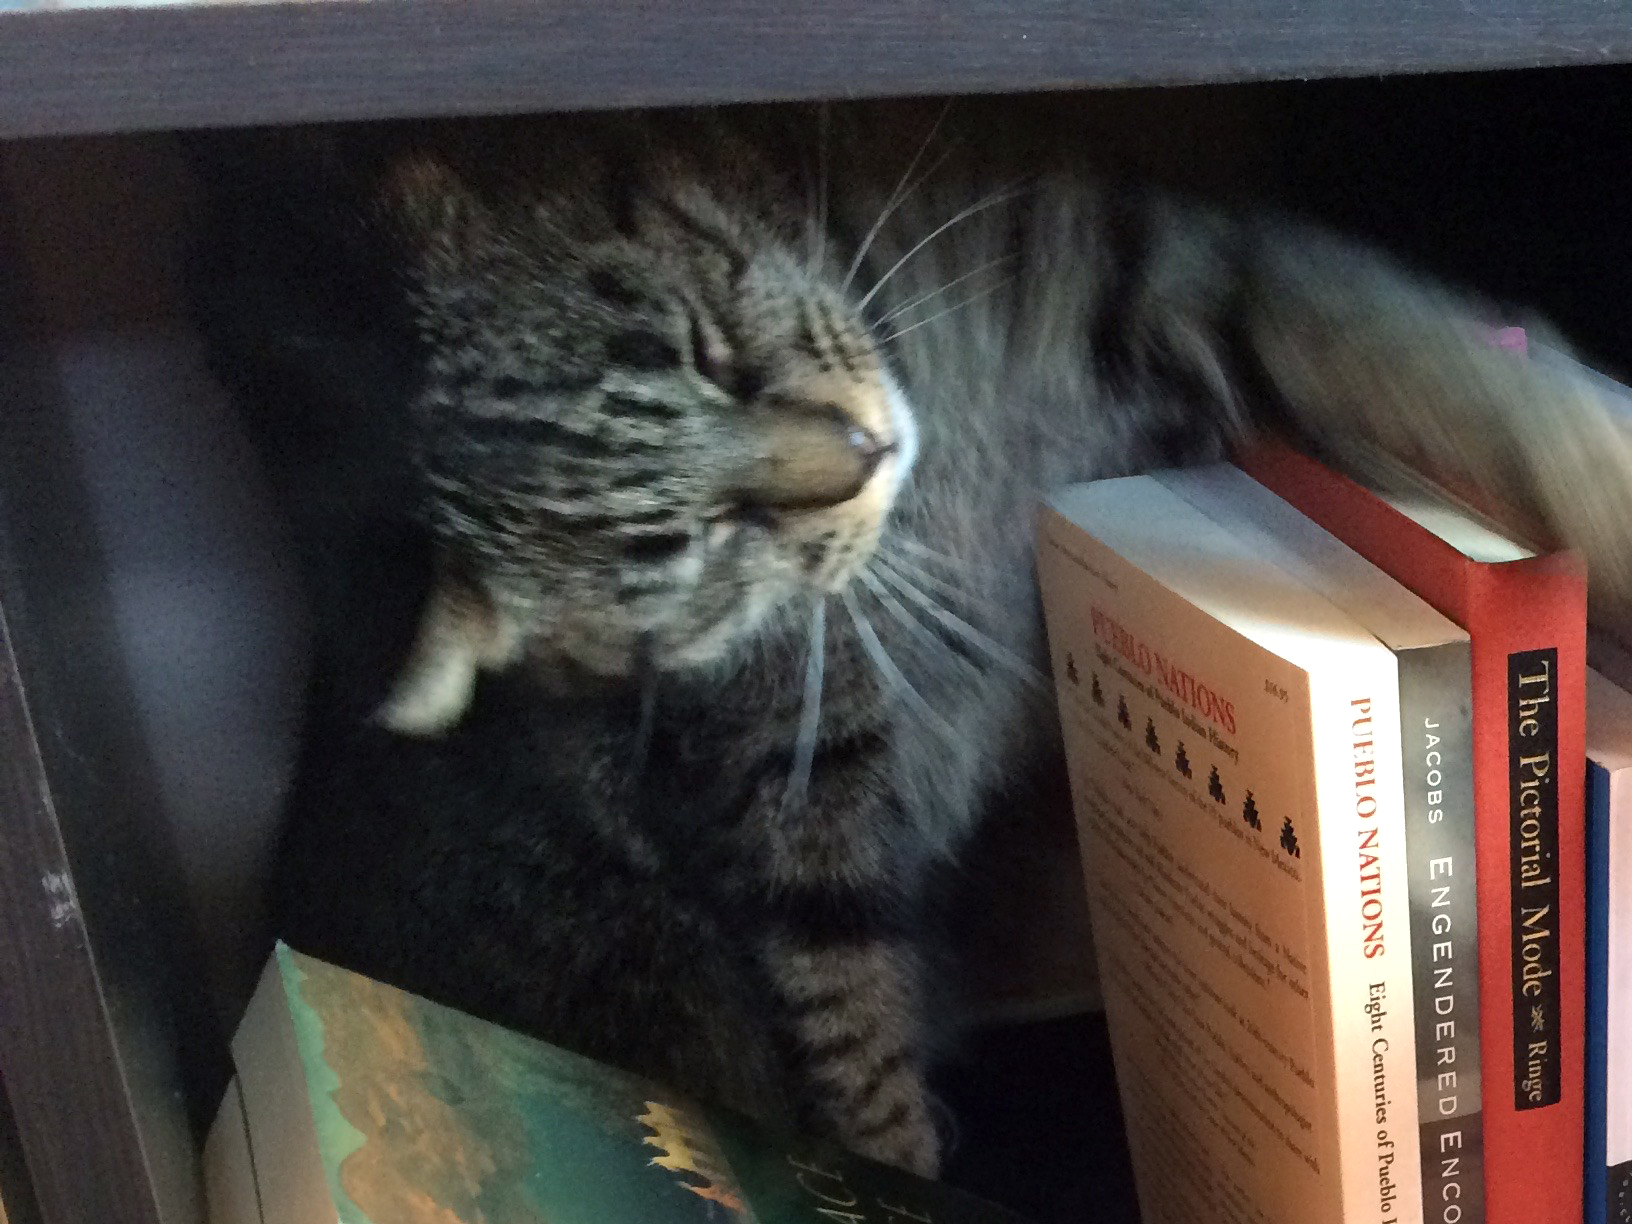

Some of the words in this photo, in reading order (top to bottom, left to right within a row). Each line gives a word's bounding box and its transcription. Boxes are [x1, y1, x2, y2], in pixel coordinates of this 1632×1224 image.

[1153, 652, 1237, 735] NATIONS
[1518, 660, 1550, 738] The
[1350, 697, 1378, 819] PUEBLO
[1424, 718, 1443, 824] JACOBS
[1519, 752, 1551, 889] Pictorial
[1357, 828, 1385, 960] NATIONS
[1429, 856, 1458, 1116] ENGENDERED
[1521, 904, 1552, 997] Mode
[1364, 981, 1387, 1033] Eight
[1372, 1038, 1393, 1125] Centuries
[1520, 1040, 1548, 1102] Ringe
[1377, 1129, 1394, 1149] of
[1378, 1151, 1396, 1213] Pueblo
